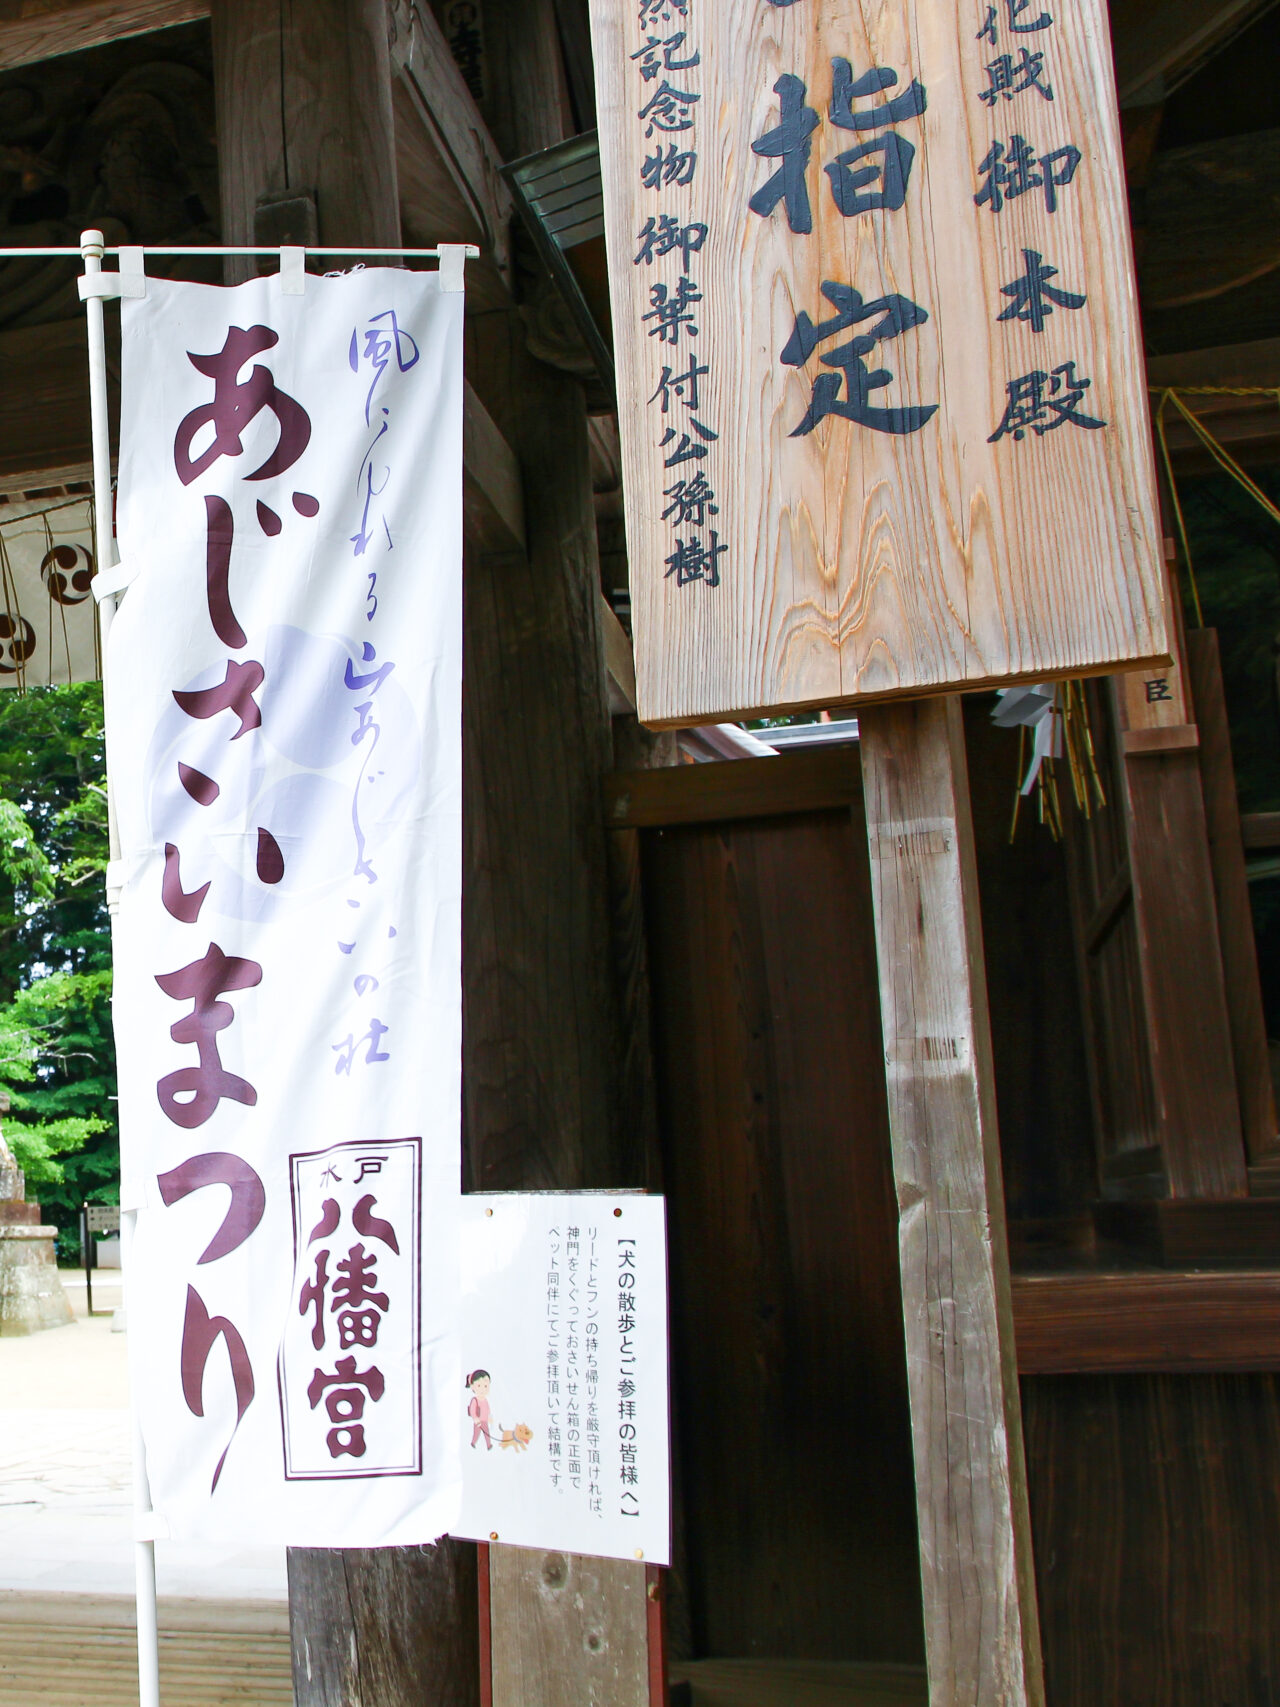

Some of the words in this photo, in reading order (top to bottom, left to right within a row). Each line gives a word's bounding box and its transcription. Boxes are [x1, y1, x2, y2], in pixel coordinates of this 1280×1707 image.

[748, 0, 940, 438] 指定
[1144, 678, 1173, 704] 臣
[154, 324, 320, 1498] あじさいまつり
[319, 1156, 390, 1186] 水戸
[299, 1194, 401, 1459] 八幡宮
[566, 1225, 581, 1490] 神門をくぐっておさいせん箱の正面で
[617, 1239, 640, 1517] 【犬の散歩とご参拝の皆様へ】
